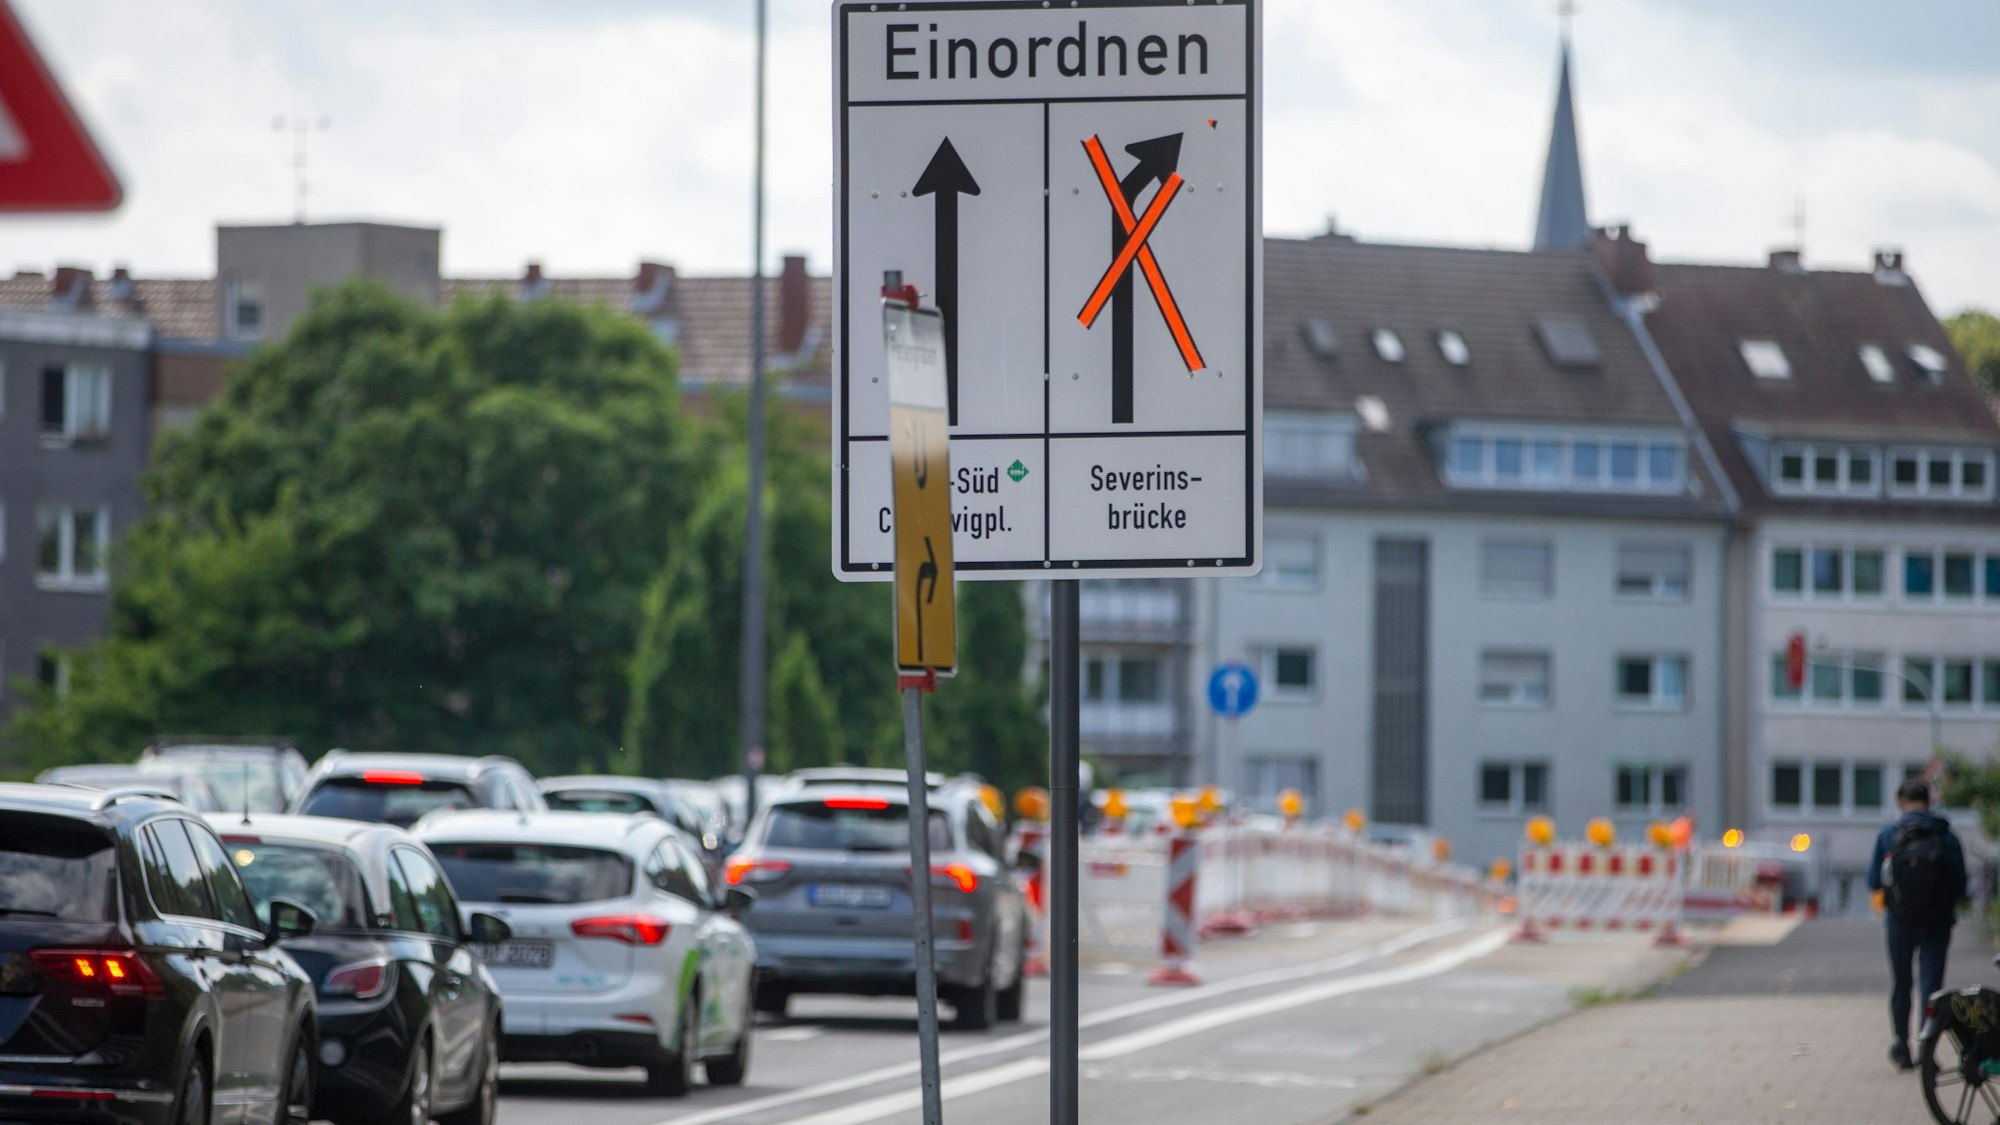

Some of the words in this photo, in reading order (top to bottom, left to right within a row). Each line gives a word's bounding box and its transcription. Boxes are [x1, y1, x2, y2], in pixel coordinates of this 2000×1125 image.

[886, 20, 1208, 80] Einordnen
[1090, 463, 1202, 491] Severins-
[1108, 502, 1187, 530] brücke
